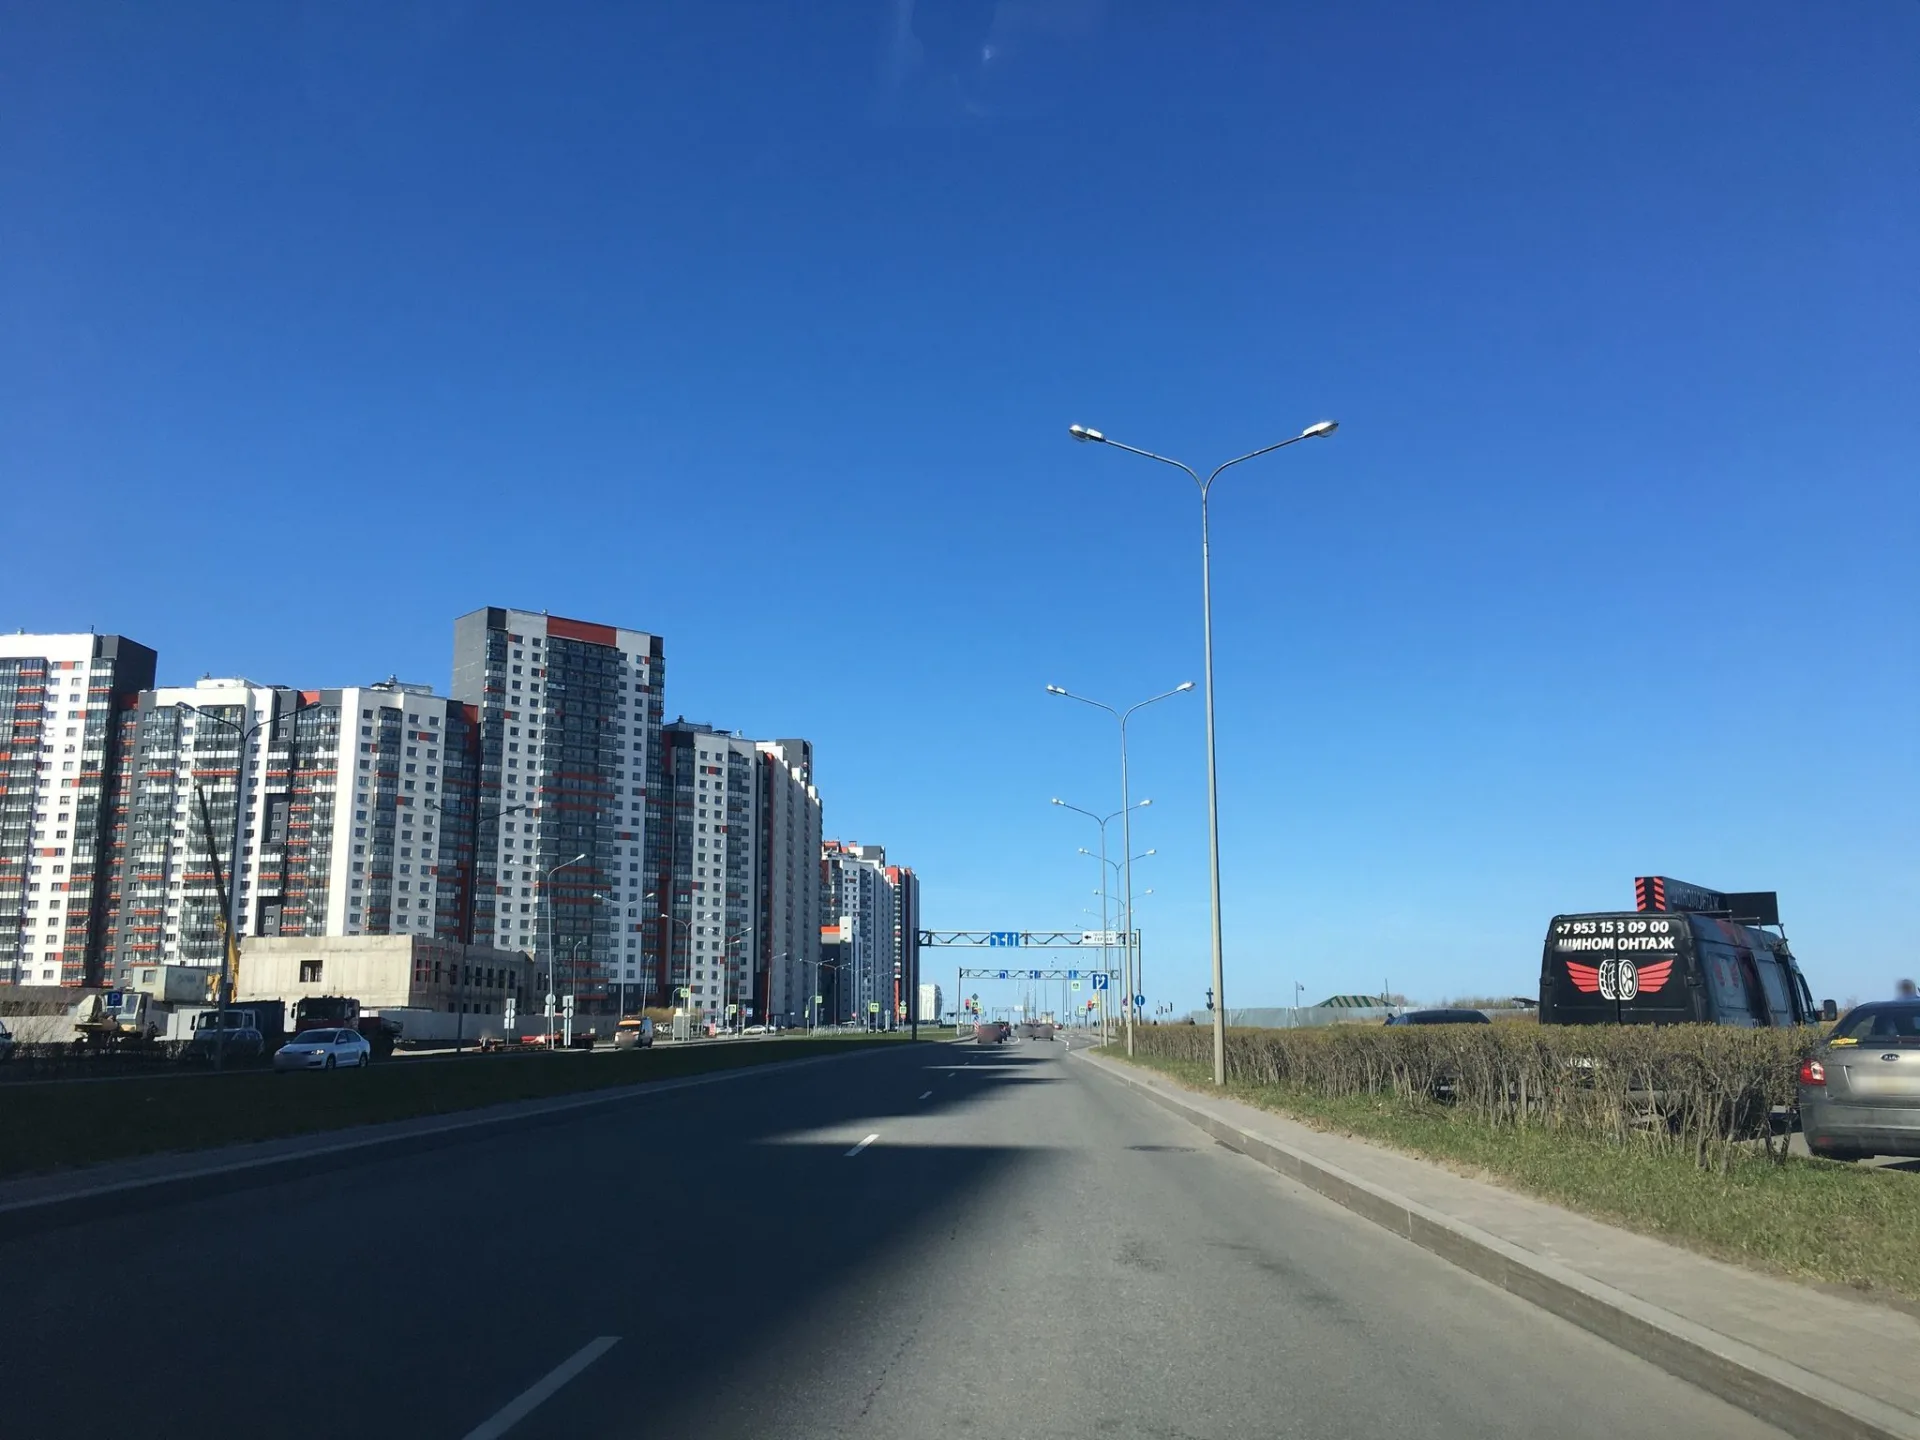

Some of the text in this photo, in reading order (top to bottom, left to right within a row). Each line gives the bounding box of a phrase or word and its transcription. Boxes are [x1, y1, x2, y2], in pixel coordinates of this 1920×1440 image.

[1556, 923, 1571, 935] +7
[1573, 922, 1597, 934] 953
[1628, 921, 1647, 933] 09
[1649, 921, 1669, 933] 00
